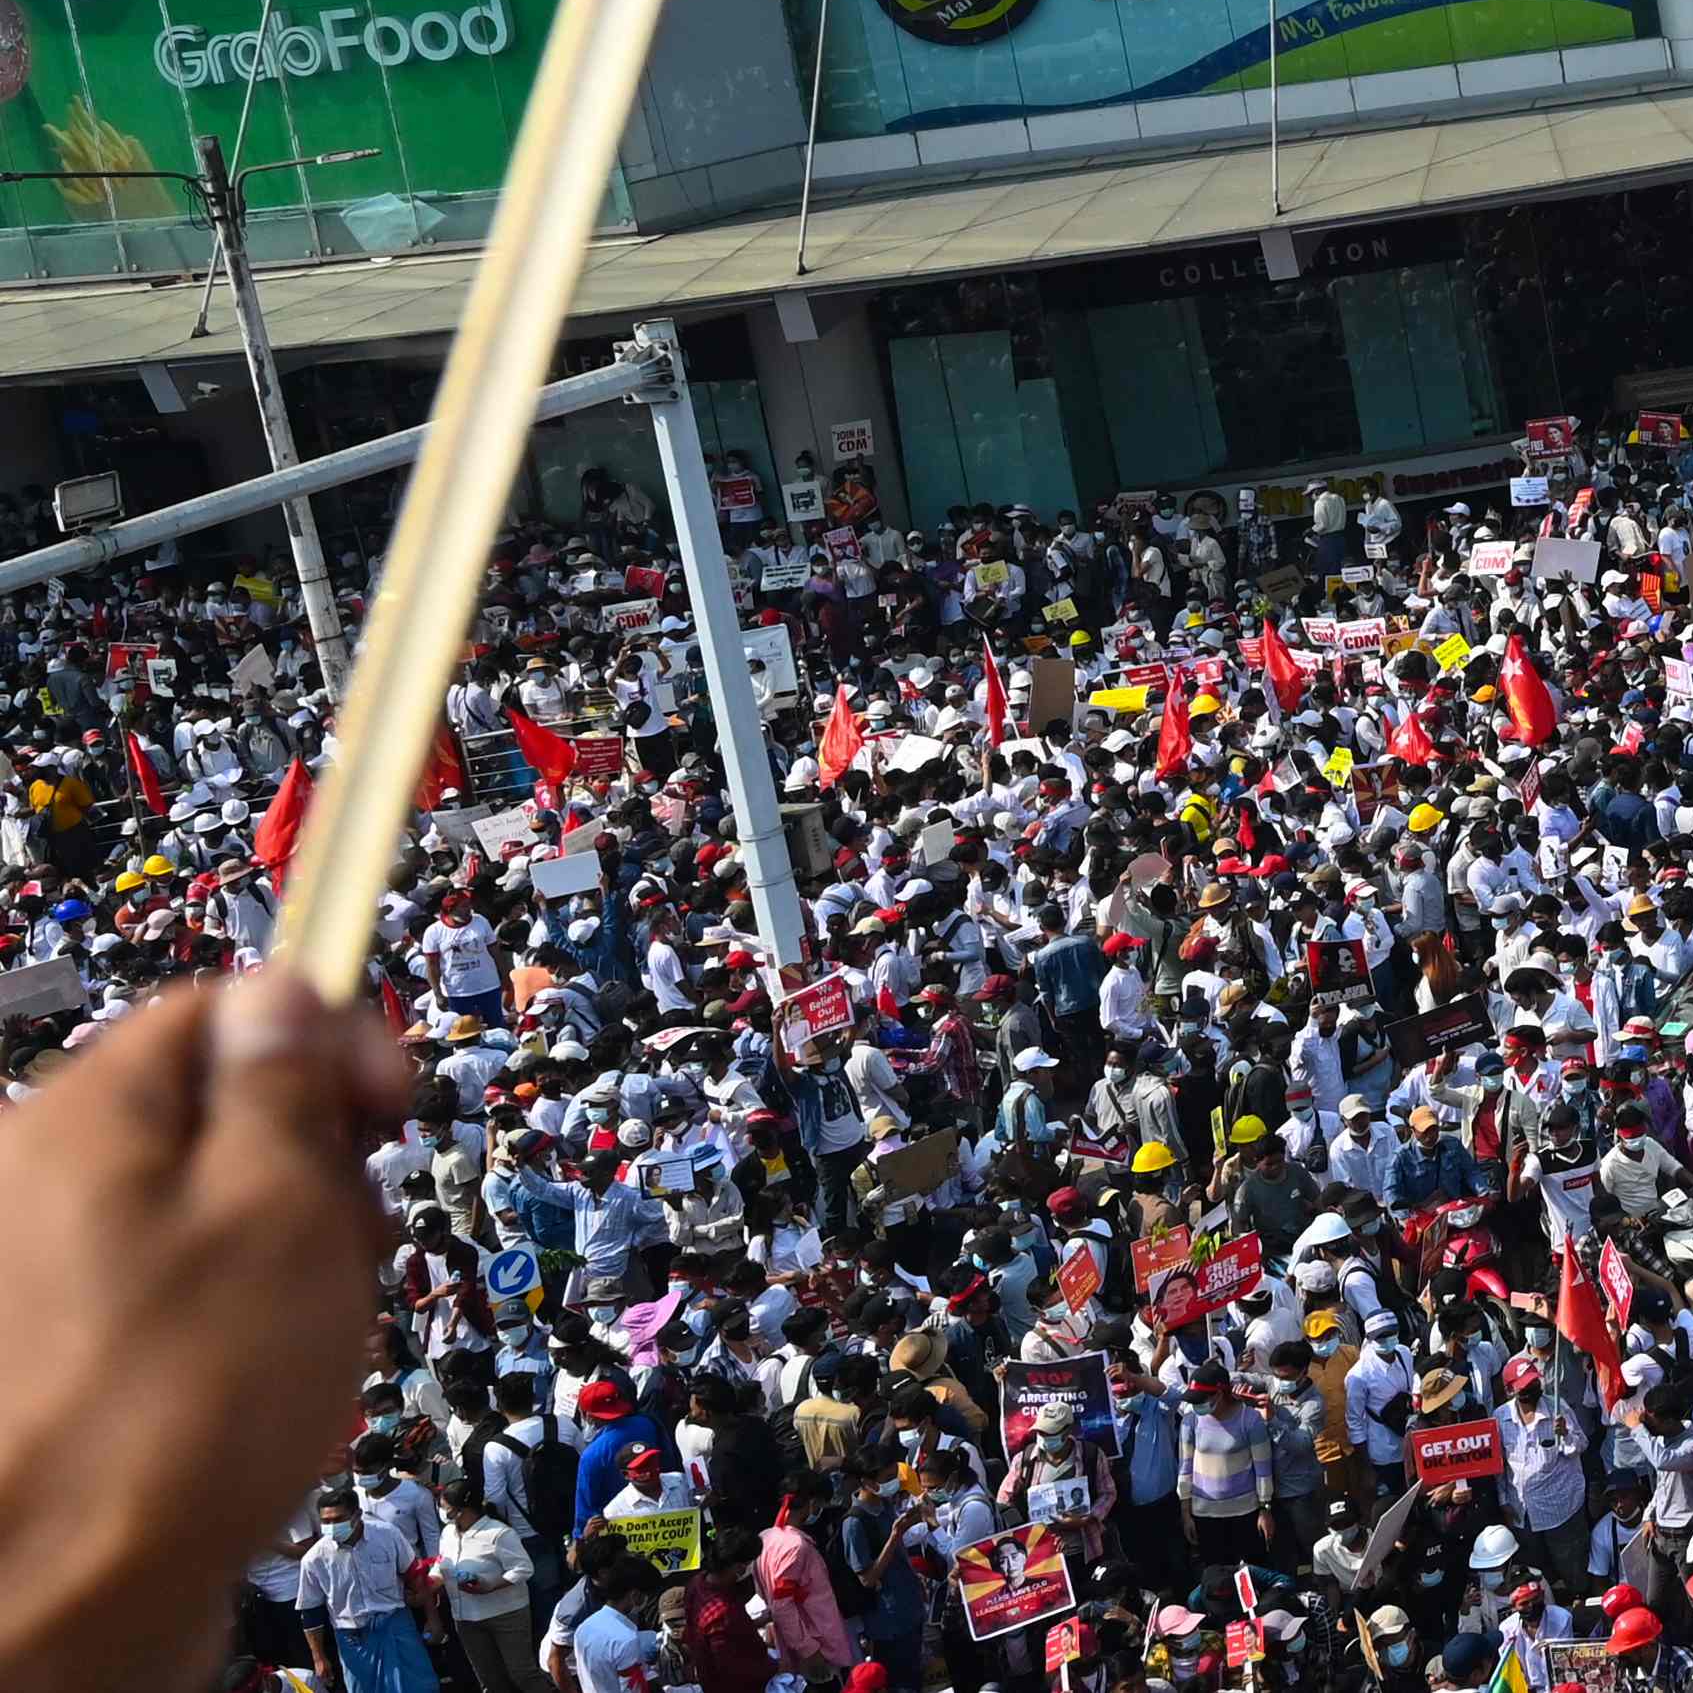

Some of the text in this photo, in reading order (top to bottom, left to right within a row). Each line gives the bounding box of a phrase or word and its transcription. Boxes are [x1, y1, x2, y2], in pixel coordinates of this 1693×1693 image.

[1278, 16, 1325, 41] My
[1159, 238, 1391, 287] COLLEION
[1344, 633, 1381, 650] CDM
[815, 984, 834, 998] We
[808, 991, 843, 1012] Believe
[817, 1004, 835, 1020] Our
[811, 1013, 846, 1033] Leader
[1204, 1253, 1240, 1273] FREE
[1198, 1262, 1261, 1298] LEADERS
[1207, 1264, 1237, 1283] OUR
[1017, 1391, 1089, 1405] ARRESTING
[1420, 1432, 1492, 1458] GET OUT
[1423, 1448, 1493, 1468] DICTATOR
[626, 1517, 660, 1533] Don't
[660, 1515, 694, 1529] Accept
[628, 1527, 692, 1547] ITARY COUP
[1425, 1543, 1445, 1557] UFC
